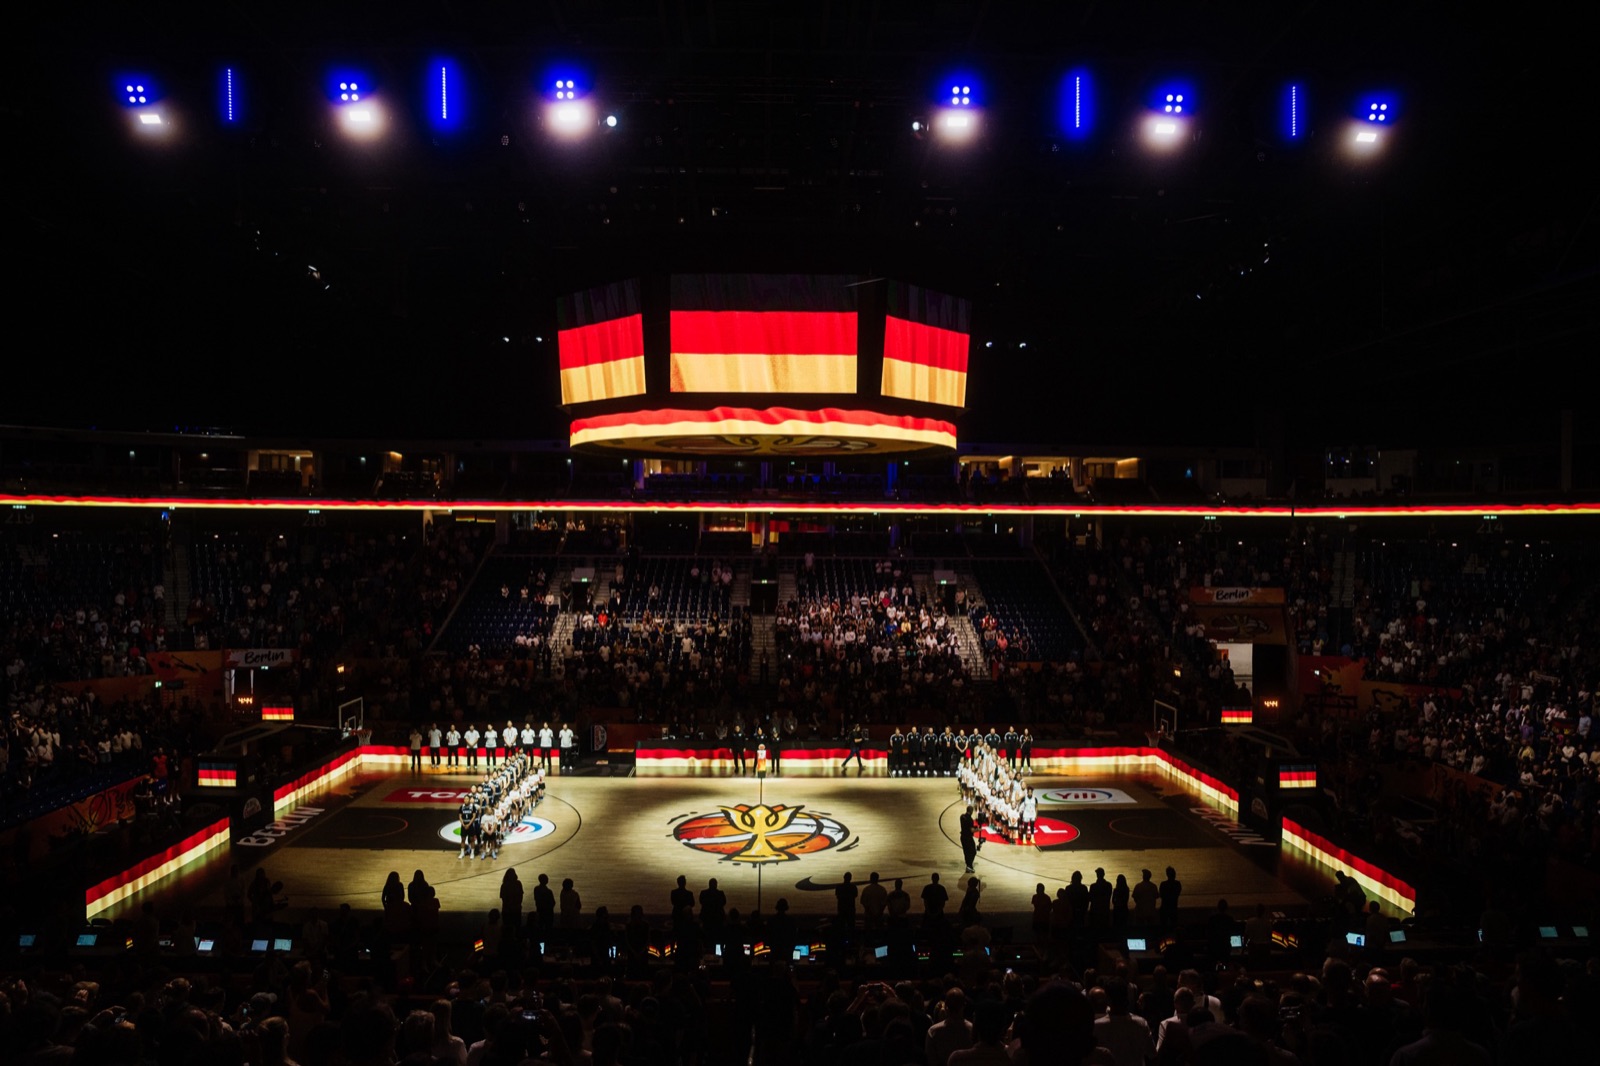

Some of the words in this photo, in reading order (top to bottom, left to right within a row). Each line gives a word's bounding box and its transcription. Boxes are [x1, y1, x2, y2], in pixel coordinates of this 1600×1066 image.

[4, 511, 35, 524] 219
[303, 515, 327, 527] 218
[1199, 521, 1222, 533] 215
[1476, 521, 1504, 533] 214
[1216, 589, 1249, 600] Berlin
[244, 650, 284, 664] Berlin
[236, 806, 325, 847] BERLIN
